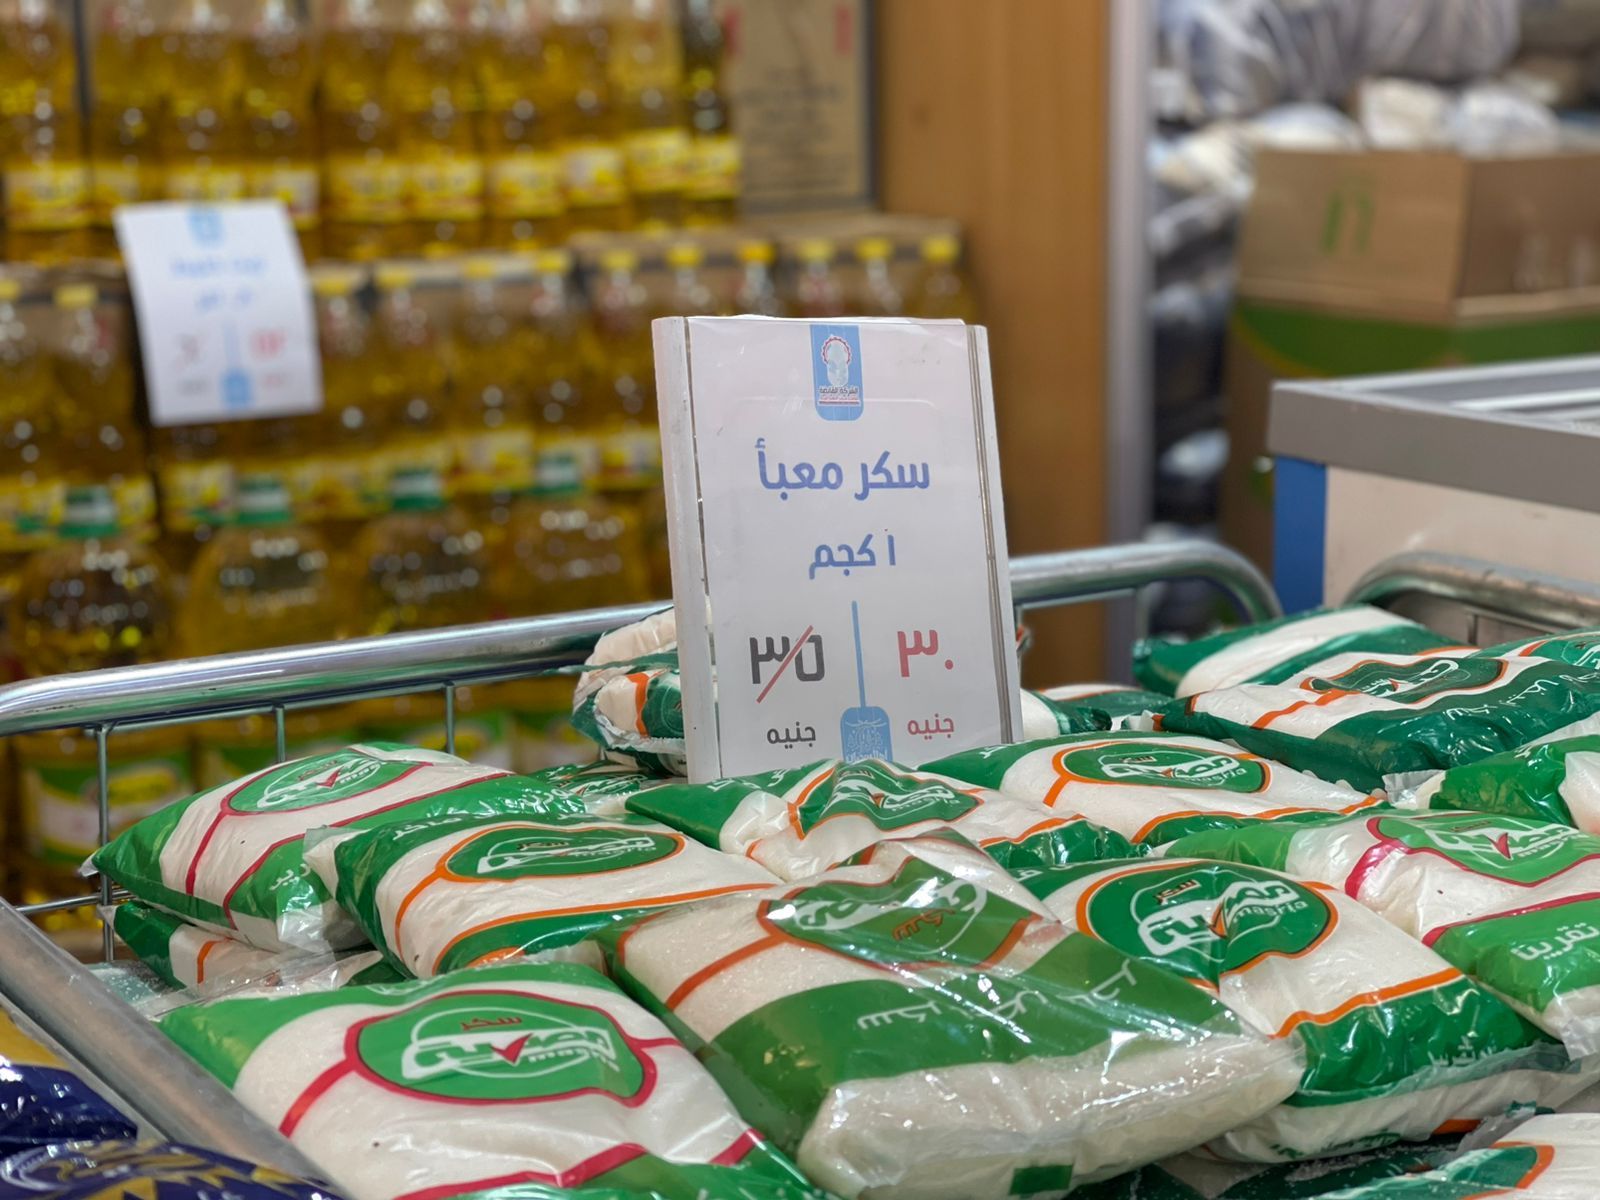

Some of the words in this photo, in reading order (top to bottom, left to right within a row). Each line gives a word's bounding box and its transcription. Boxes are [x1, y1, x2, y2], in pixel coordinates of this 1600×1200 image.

[754, 438, 844, 500] معبأ
[854, 451, 930, 500] سكر
[808, 533, 876, 580] كجم
[897, 629, 954, 678] ٣٠
[766, 721, 816, 749] جنيه
[907, 713, 954, 740] جنيه
[461, 1015, 523, 1032] سكر
